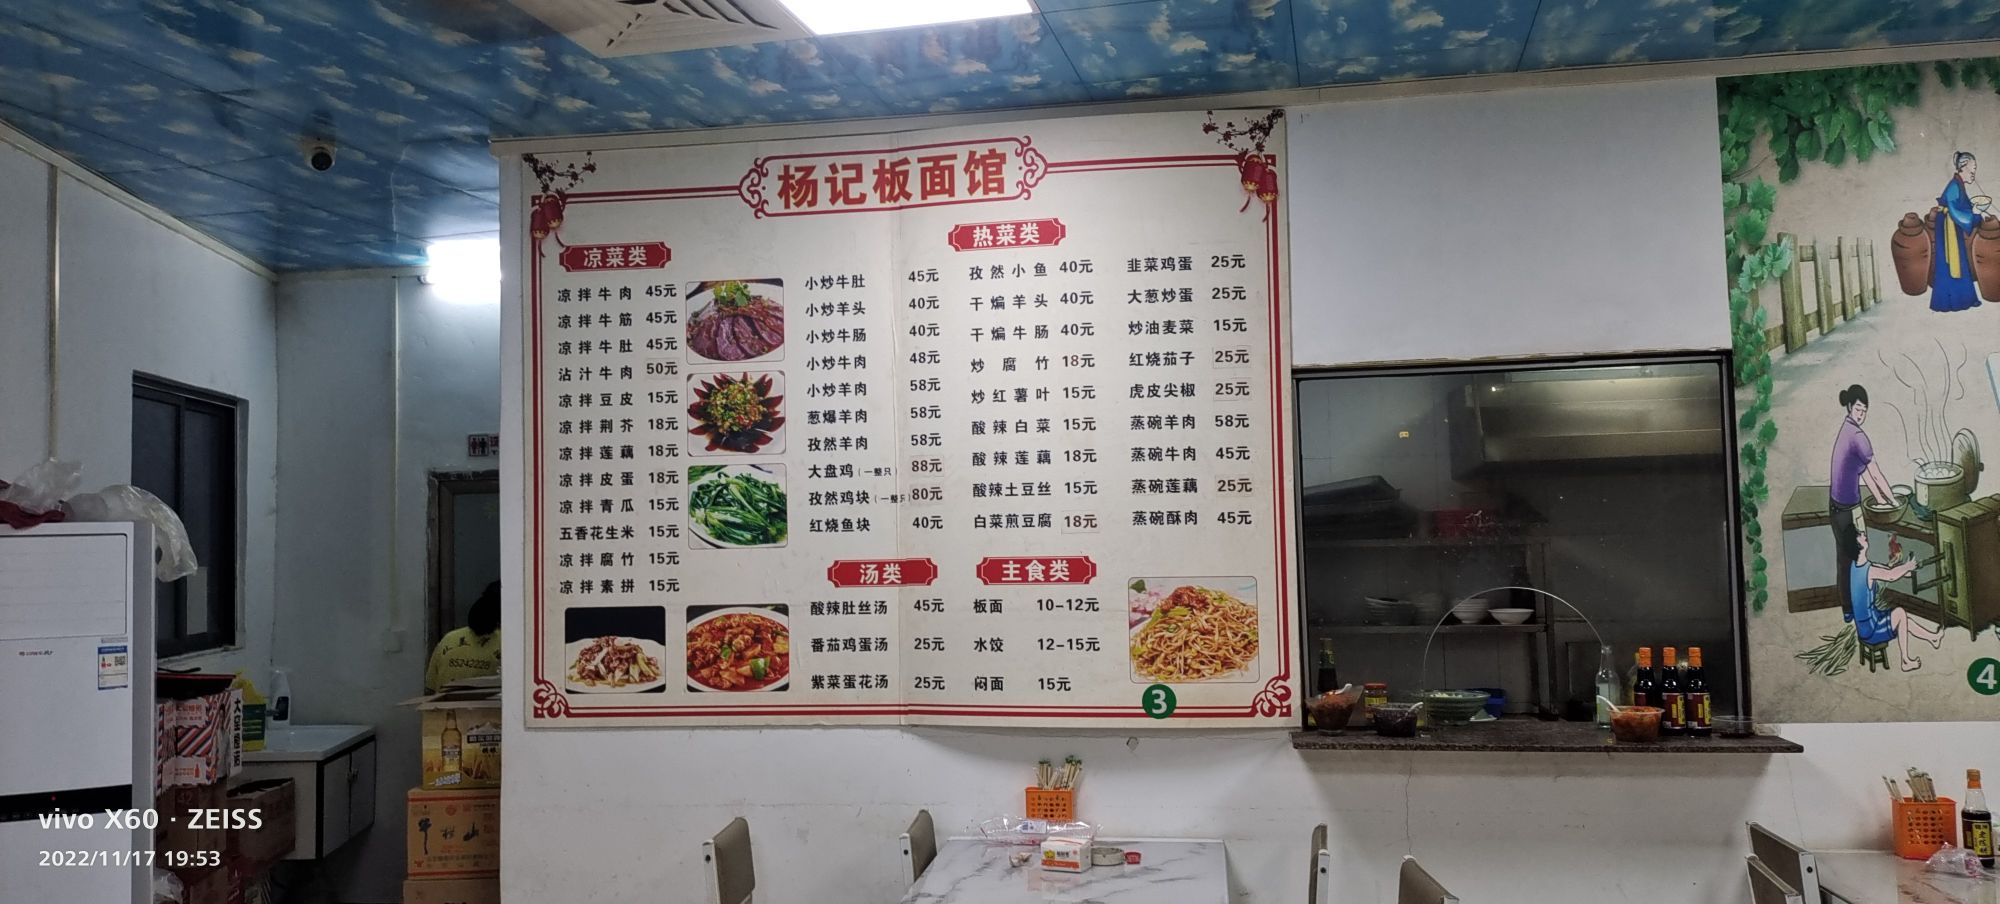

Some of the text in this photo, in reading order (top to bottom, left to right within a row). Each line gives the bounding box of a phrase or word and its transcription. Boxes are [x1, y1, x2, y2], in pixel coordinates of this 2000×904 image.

[777, 148, 1008, 210] 杨记板面馆
[972, 222, 1041, 248] 热菜类
[583, 246, 648, 269] 凉菜类
[1127, 254, 1246, 273] 韭菜鸡蛋 25元
[804, 268, 940, 291] 小炒牛肚 45元
[969, 259, 1094, 281] 孜然小鱼 40元
[557, 283, 677, 303] 凉拌牛肉 45元
[969, 290, 1094, 312] 干煸羊头 40元
[1127, 286, 1247, 305] 大葱炒蛋 25元
[805, 295, 940, 318] 小炒羊头 40元
[557, 310, 678, 330] 凉拌牛筋 45元
[1128, 317, 1248, 336] 炒油麦菜 15元
[805, 323, 940, 345] 小炒牛肠 40元
[970, 322, 1095, 343] 干煸牛肠 40元
[558, 336, 678, 356] 凉拌牛肚 45元
[806, 350, 941, 371] 小炒牛肉 48元
[970, 353, 1096, 374] 炒腐竹 18元
[1128, 349, 1250, 367] 红烧茄子 25元
[646, 361, 678, 376] 50元
[806, 377, 941, 398] 小炒羊肉 58元
[971, 385, 1096, 405] 炒红薯叶 15元
[1129, 381, 1250, 399] 虎皮尖椒 25元
[558, 390, 679, 409] 凉拌豆皮 15元
[807, 405, 942, 425] 葱爆羊肉 58元
[1130, 413, 1250, 431] 蒸碗羊肉 58元
[558, 416, 679, 435] 凉拌荆芥 18元
[971, 416, 1097, 436] 酸辣白菜 15元
[807, 432, 942, 452] 孜然羊肉 58元
[559, 443, 679, 462] 凉拌莲藕 18元
[972, 448, 1097, 467] 酸辣莲藕 18元
[1131, 445, 1251, 462] 蒸碗牛肉 45元
[807, 463, 854, 479] 大盘鸡
[911, 458, 943, 473] 88元
[559, 470, 679, 488] 凉拌皮蛋 18元
[1131, 477, 1253, 494] 蒸碗莲藕 25元
[808, 490, 870, 506] 孜然鸡块
[912, 486, 943, 501] 80元
[972, 480, 1098, 498] 酸辣土豆丝 15元
[559, 497, 680, 515] 凉拌青瓜 15元
[809, 515, 944, 533] 红烧鱼块 40元
[974, 512, 1098, 529] 白菜煎豆腐 18元
[1132, 509, 1253, 526] 蒸碗酥肉 45元
[559, 524, 680, 541] 五香花生米 15元
[559, 551, 680, 568] 凉拌腐竹 15元
[859, 563, 902, 584] 汤类
[1001, 560, 1071, 582] 主食类
[559, 578, 680, 595] 凉拌素拼 15元
[810, 598, 945, 616] 酸辣肚丝汤 45元
[973, 598, 1003, 614] 板面
[810, 637, 945, 653] 番茄鸡蛋汤 25元
[973, 636, 1004, 653] 水饺
[811, 674, 946, 691] 紫菜蛋花汤 25元
[974, 675, 1072, 692] 闷面 15元
[1976, 663, 1997, 690] 4
[1151, 689, 1168, 715] 3
